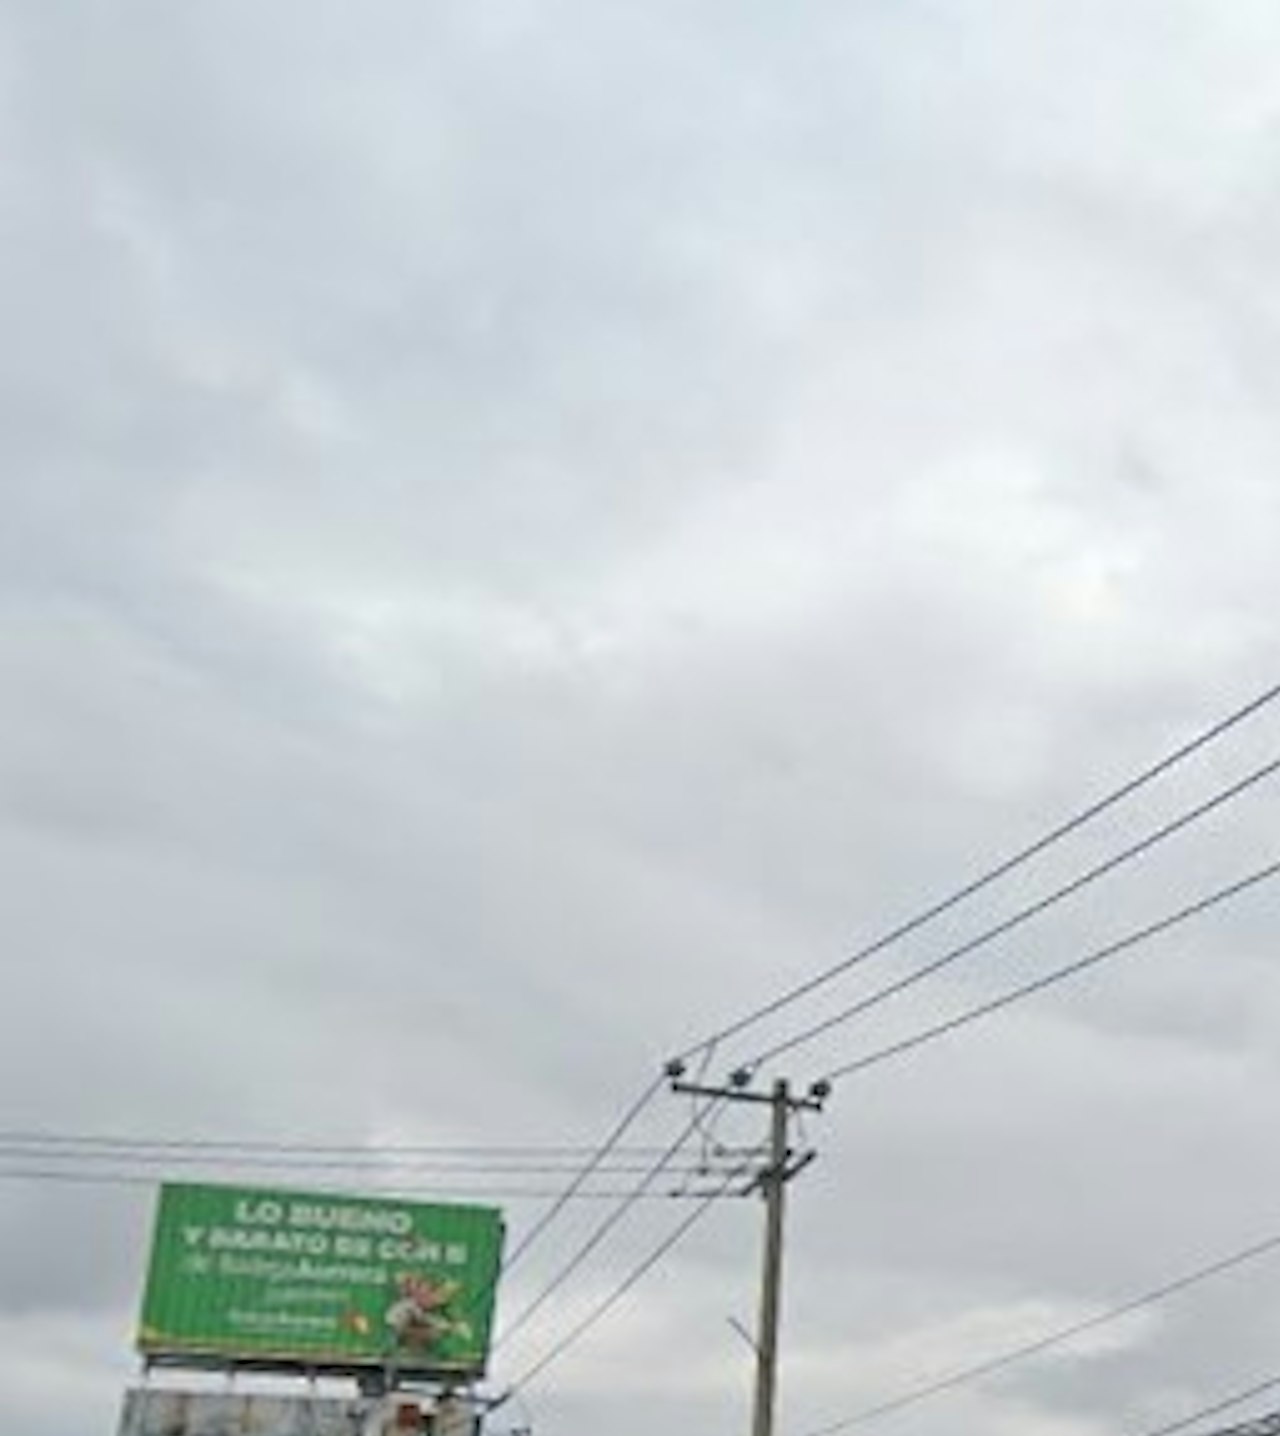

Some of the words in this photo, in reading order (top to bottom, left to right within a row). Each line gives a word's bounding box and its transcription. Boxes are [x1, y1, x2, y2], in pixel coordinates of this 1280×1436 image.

[234, 1200, 283, 1224] LO
[289, 1204, 413, 1234] BUENO
[183, 1226, 204, 1245] Y
